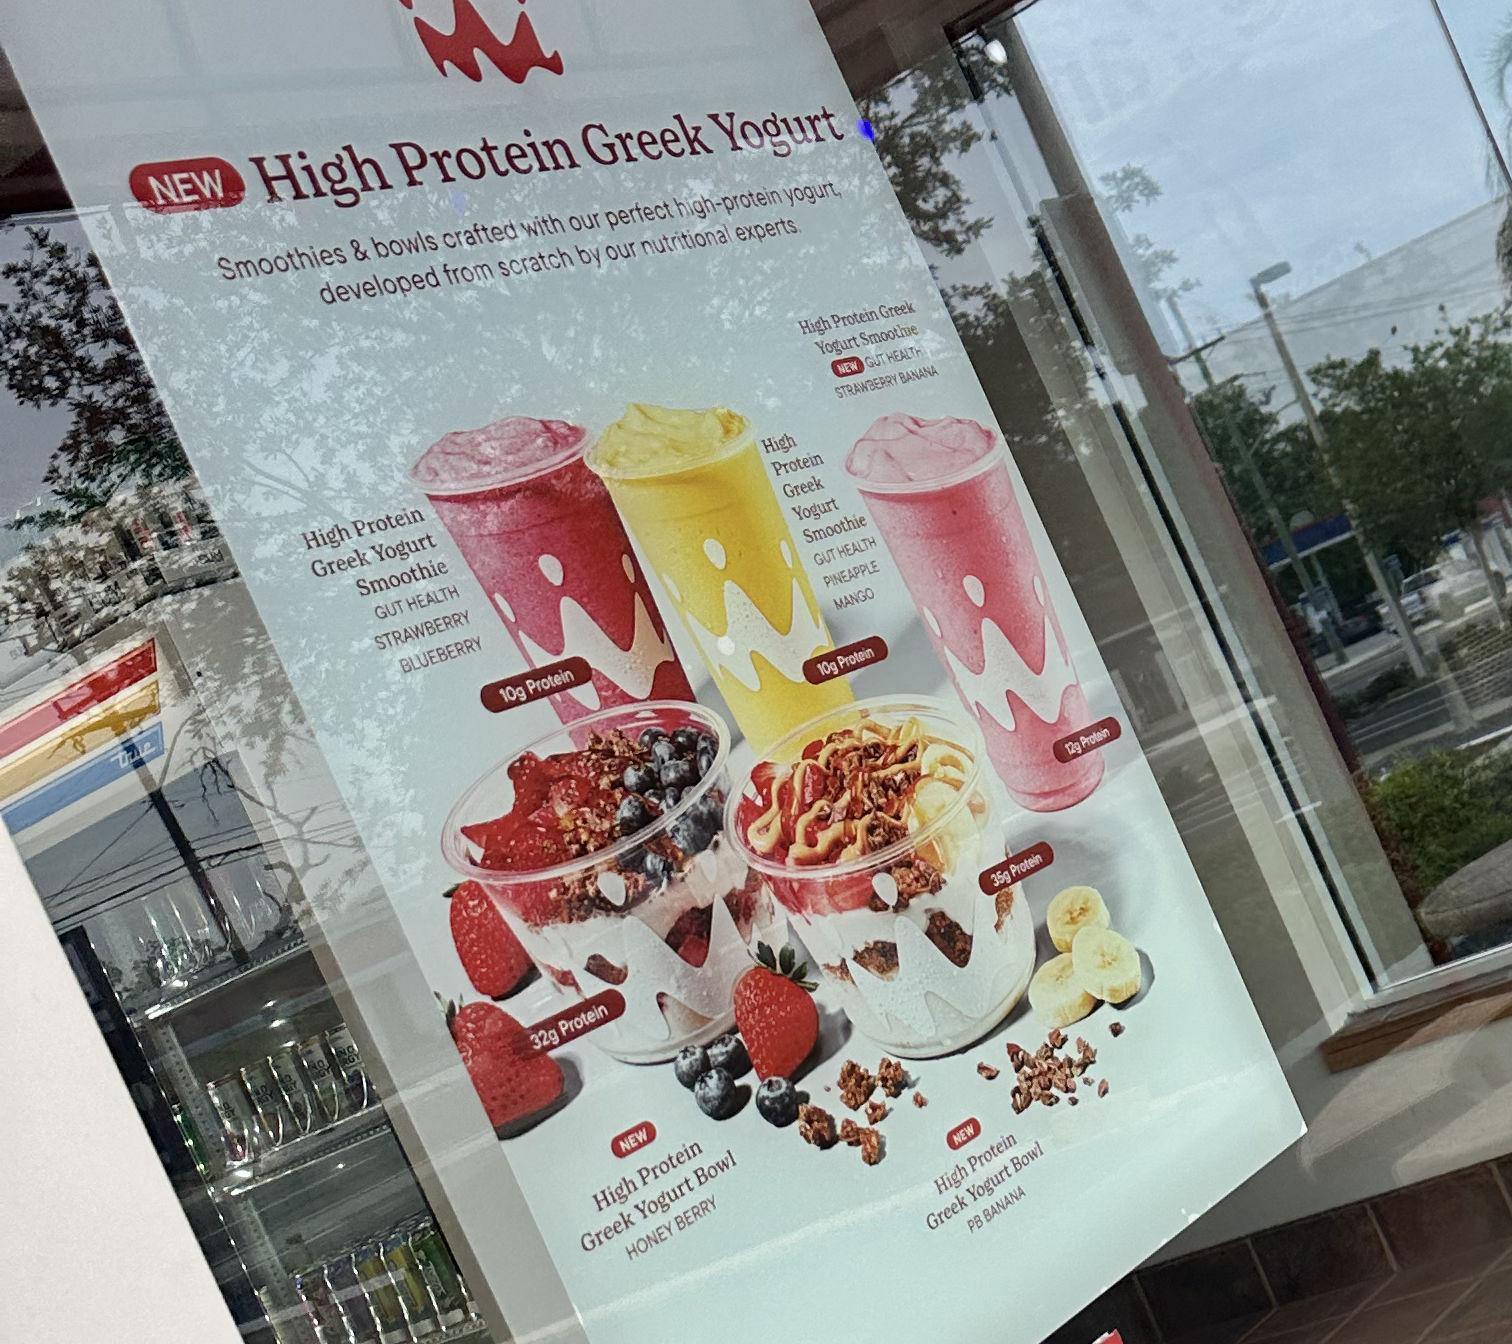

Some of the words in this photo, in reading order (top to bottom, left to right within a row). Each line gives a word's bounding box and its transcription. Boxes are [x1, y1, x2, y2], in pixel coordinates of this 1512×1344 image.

[148, 169, 224, 205] NEW
[249, 145, 393, 207] High
[388, 130, 582, 187] Protein
[582, 114, 714, 166] Greek
[708, 106, 844, 157] Yogurt
[218, 246, 347, 280] Smoothies
[350, 239, 368, 262] &
[371, 231, 438, 259] bowls
[443, 219, 517, 249] crafted
[521, 214, 569, 238] with
[570, 214, 601, 233] our
[605, 202, 675, 231] perfect
[676, 188, 782, 220] high-protein
[786, 180, 842, 208] yogurt,
[320, 266, 440, 305] developed
[443, 262, 494, 287] from
[500, 247, 574, 278] scratch
[578, 245, 601, 268] by
[606, 243, 636, 261] our
[640, 224, 732, 256] nutritional
[736, 216, 801, 242] experts.
[799, 317, 832, 335] High
[831, 308, 879, 328] Protein
[879, 300, 916, 319] Greek
[815, 336, 860, 355] Yogurt
[860, 323, 919, 346] Smoothie
[837, 361, 858, 374] NEW
[865, 353, 886, 368] GUT
[887, 347, 922, 364] HEALTH
[835, 374, 898, 398] STRAWBERRY
[899, 365, 939, 384] BANANA
[762, 433, 797, 454] High
[771, 451, 824, 476] Protein
[783, 476, 824, 498] Greek
[792, 497, 839, 521] Yogurt
[302, 524, 353, 550] High
[352, 508, 425, 537] Protein
[803, 514, 868, 544] Smoothie
[311, 549, 372, 577] Greek
[371, 532, 437, 562] Yogurt
[813, 548, 837, 566] GUT
[839, 536, 877, 557] HEALTH
[356, 560, 449, 596] Smoothie
[823, 560, 880, 588] PINEAPPLE
[375, 599, 404, 619] GUT
[406, 585, 460, 611] HEALTH
[833, 587, 875, 610] MANGO
[374, 609, 471, 650] STRAWBERRY
[400, 636, 482, 674] BLUEBERRY
[816, 658, 838, 676] 10g
[837, 646, 875, 670] Protein
[499, 686, 527, 703] 10g
[526, 669, 575, 694] Protein
[110, 742, 156, 768] true
[1064, 741, 1082, 756] 12g
[1080, 728, 1111, 748] Protein
[990, 870, 1012, 887] 35g
[1009, 853, 1043, 877] Protein
[530, 1029, 560, 1049] 32g
[558, 1004, 609, 1036] Protein
[618, 1127, 648, 1153] NEW
[952, 1123, 975, 1146] NEW
[592, 1177, 639, 1212] High
[636, 1142, 703, 1187] Protein
[934, 1164, 969, 1195] High
[967, 1134, 1018, 1172] Protein
[580, 1211, 636, 1251] Greek
[634, 1176, 695, 1220] Yogurt
[693, 1149, 738, 1187] Bowl
[926, 1194, 968, 1230] Greek
[966, 1164, 1012, 1202] Yogurt
[1010, 1141, 1044, 1173] Bowl
[967, 1214, 984, 1233] PB
[983, 1185, 1027, 1223] BANANA
[625, 1220, 674, 1261] HONEY
[674, 1194, 717, 1231] BERRY
